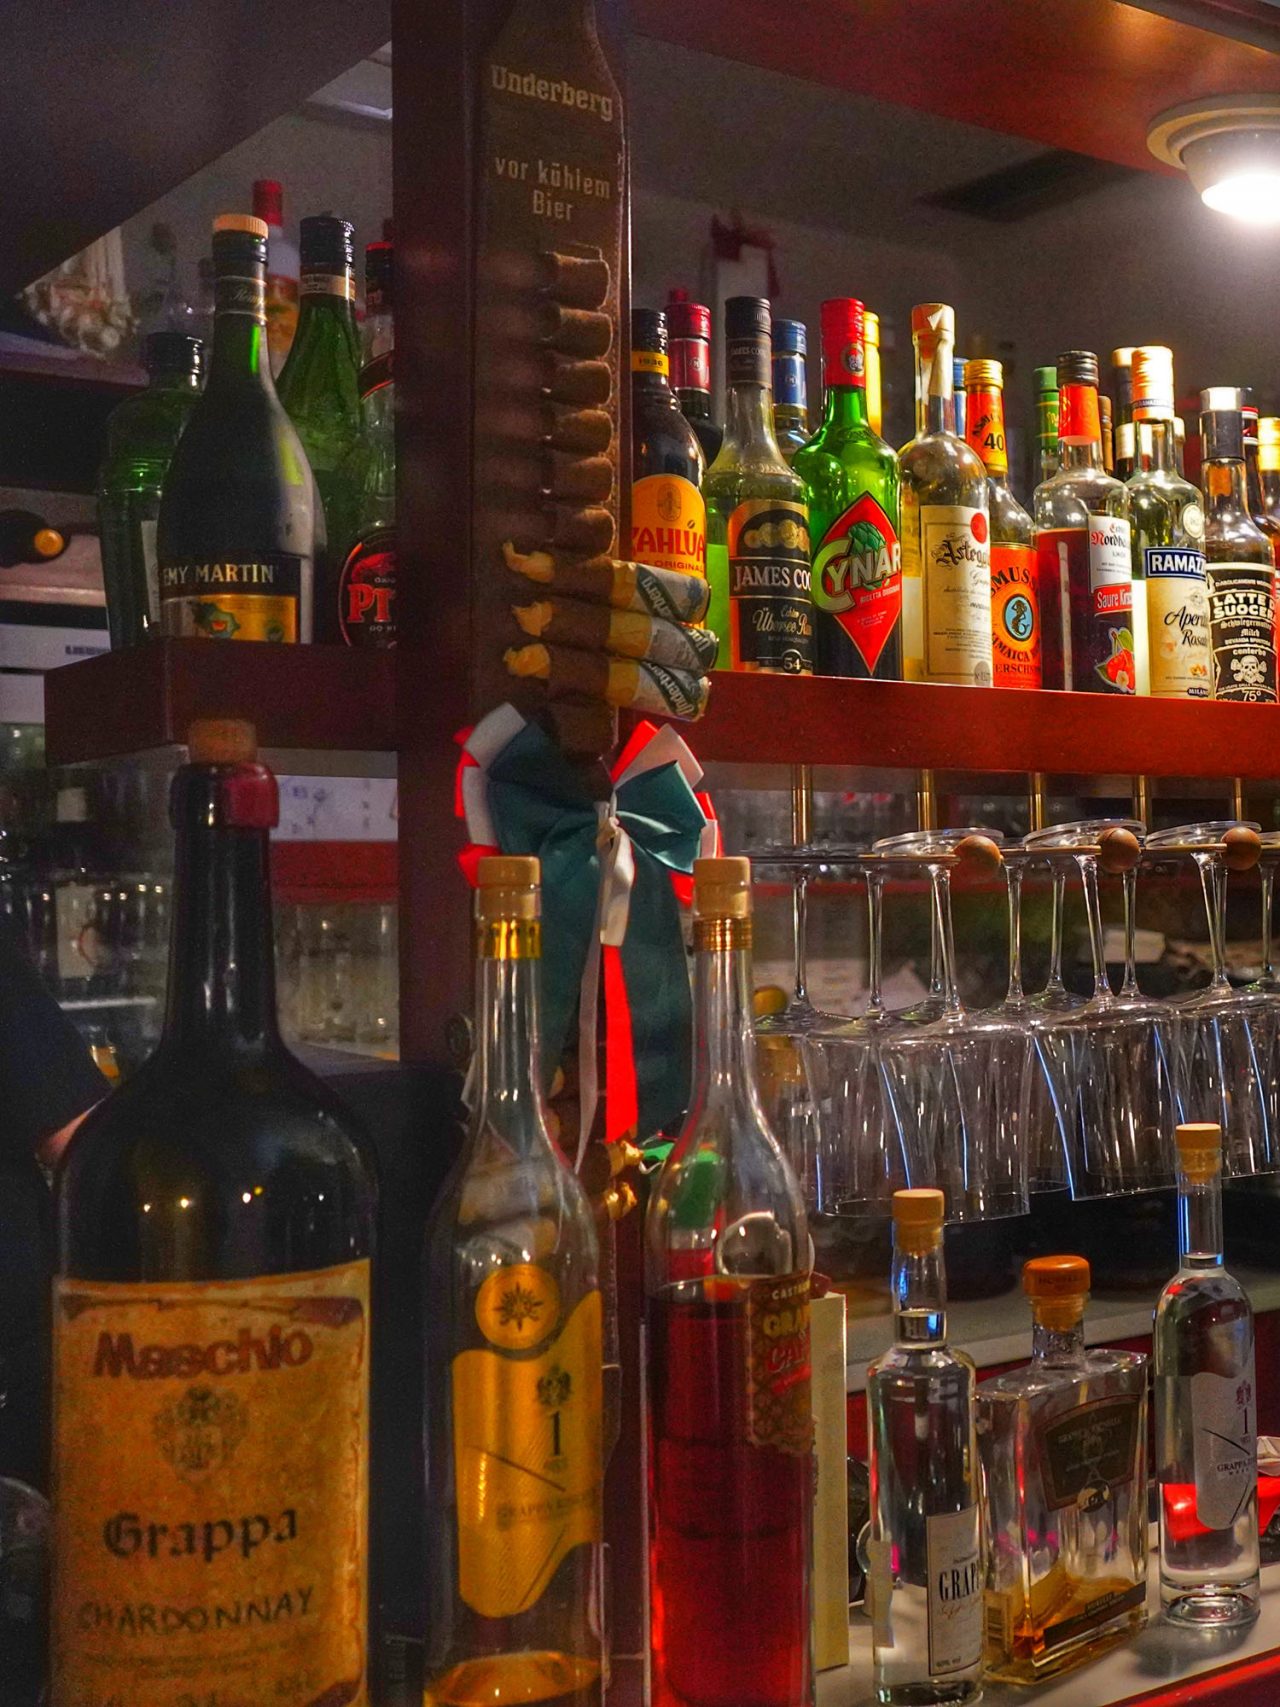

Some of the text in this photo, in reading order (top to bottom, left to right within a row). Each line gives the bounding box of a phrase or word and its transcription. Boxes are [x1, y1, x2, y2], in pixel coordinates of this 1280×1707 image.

[491, 64, 613, 122] Underberg
[495, 157, 611, 199] vor kühlem
[533, 189, 574, 221] Bier
[984, 433, 1004, 451] 40
[195, 563, 274, 584] MARTIN
[733, 565, 791, 592] JAMES
[811, 537, 902, 613] CYNAR
[1097, 589, 1119, 609] Saure
[1213, 592, 1266, 608] LATTE
[784, 658, 801, 671] 54
[94, 1323, 314, 1380] Maschio
[103, 1508, 298, 1563] Grappa
[80, 1585, 314, 1637] CHARDONNAY
